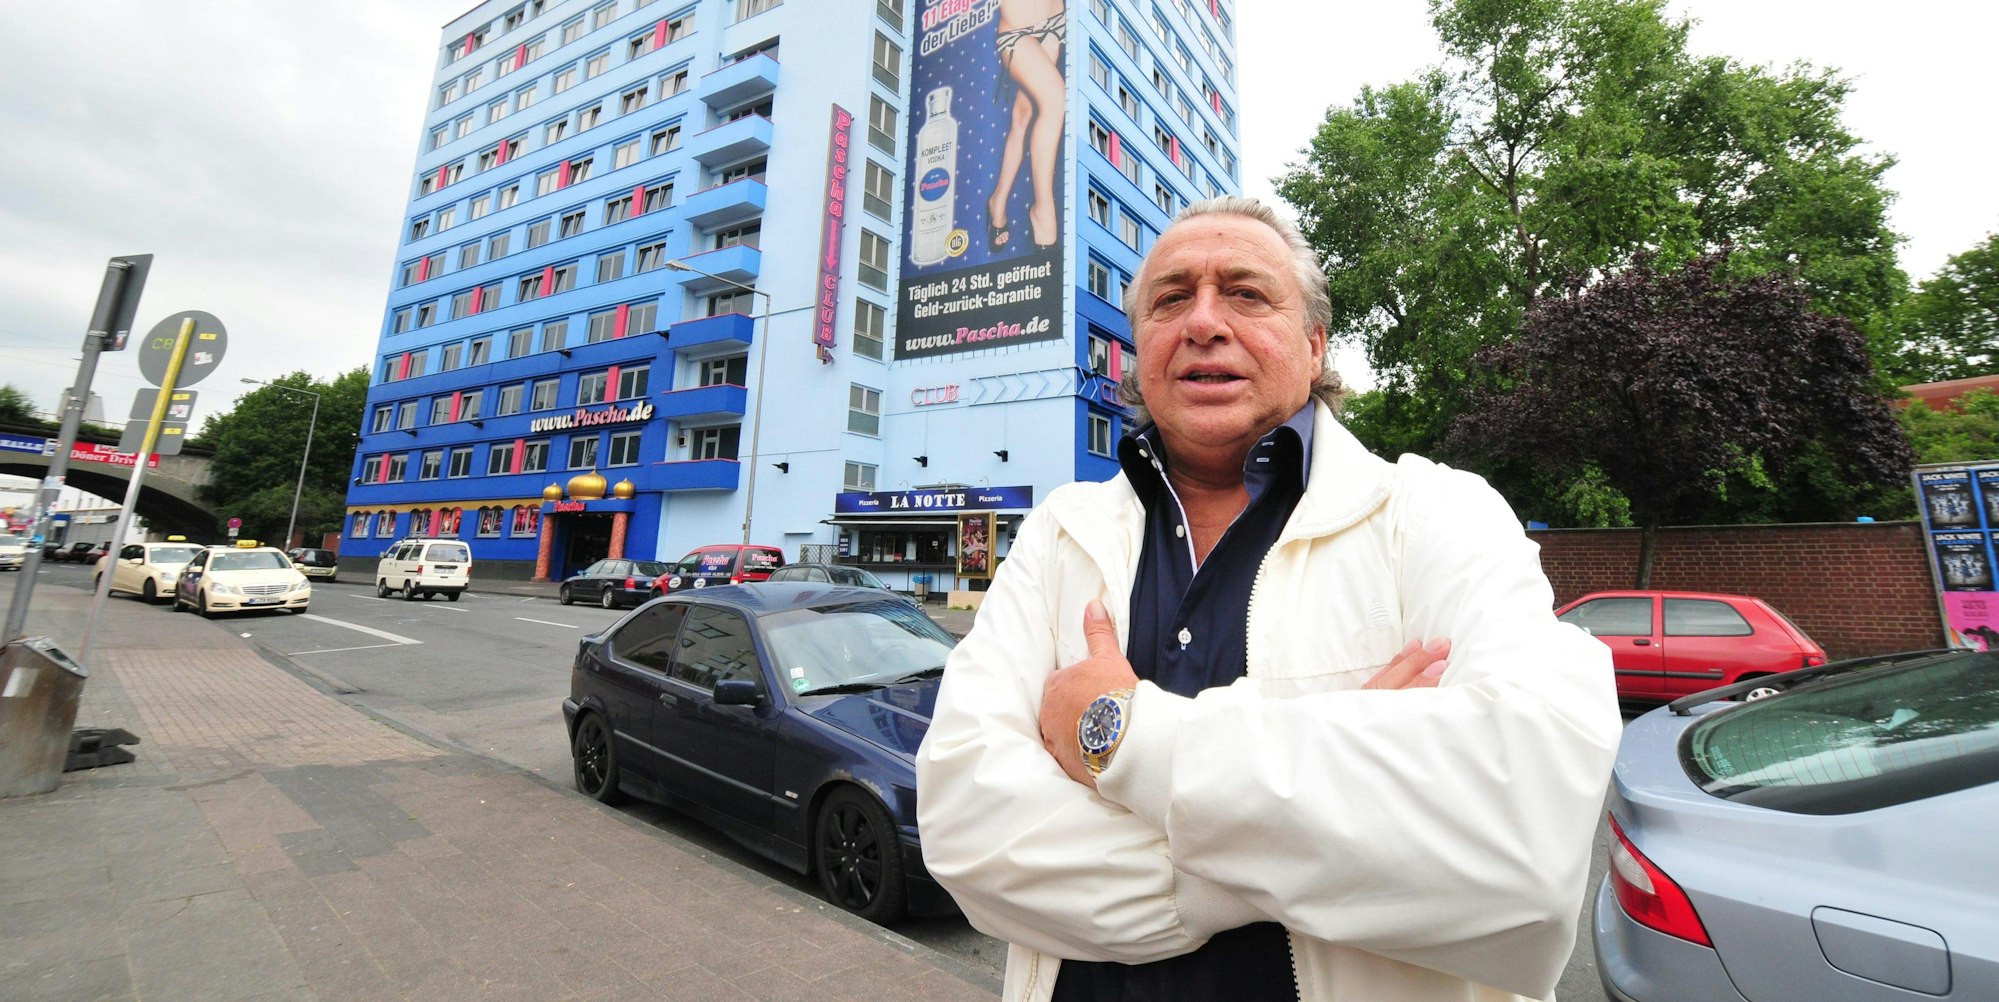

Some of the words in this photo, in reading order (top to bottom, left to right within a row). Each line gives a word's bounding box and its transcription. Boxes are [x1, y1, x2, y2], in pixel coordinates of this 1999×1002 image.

[924, 7, 937, 29] 11
[940, 0, 977, 20] Etag
[923, 31, 946, 54] der
[921, 142, 952, 158] KOMPLEET
[927, 155, 945, 164] VODKA
[830, 110, 851, 218] Pascha
[908, 281, 948, 303] Täglich
[952, 277, 967, 294] 24
[970, 273, 993, 291] Std.
[997, 261, 1051, 290] geöffnet
[820, 274, 836, 341] CLUB
[914, 284, 1042, 319] Geld-zurück-Garantie
[905, 316, 1050, 351] www.Pascha.de
[910, 383, 958, 405] CLUB
[530, 400, 654, 433] www.Pascha.de
[69, 449, 106, 462] Döner
[858, 499, 879, 507] Pizzeria
[890, 495, 909, 508] LA
[914, 493, 966, 508] NOTTE
[701, 554, 730, 566] Pascha
[752, 553, 778, 562] Pascha
